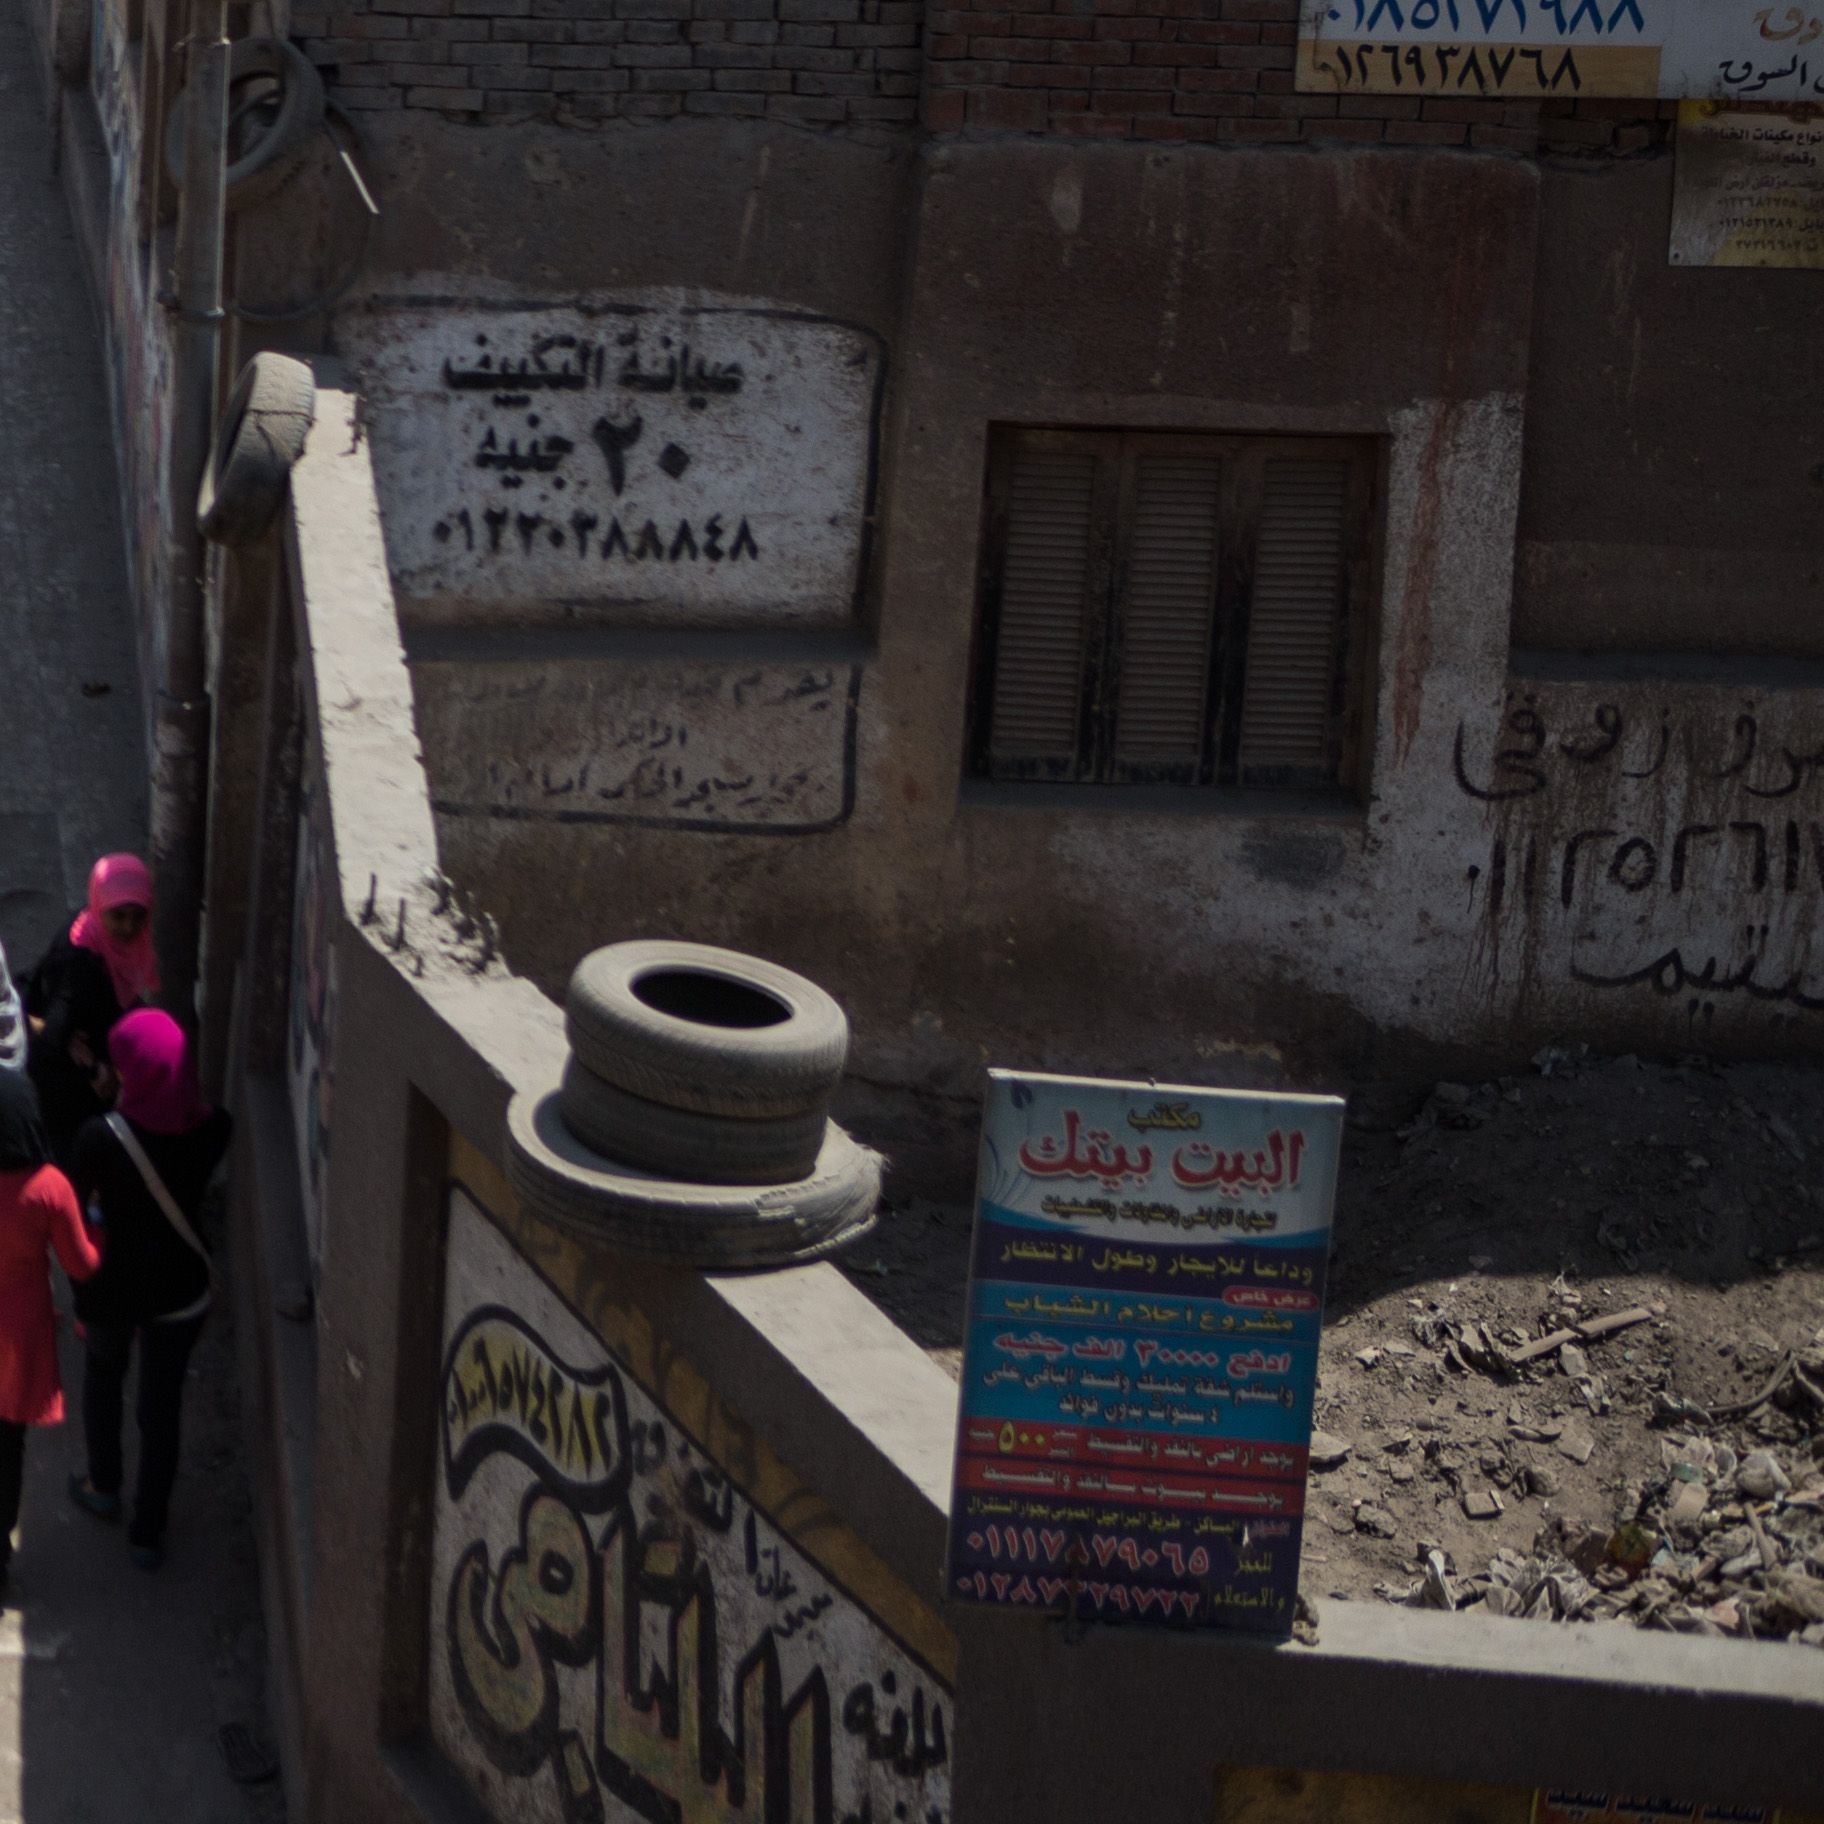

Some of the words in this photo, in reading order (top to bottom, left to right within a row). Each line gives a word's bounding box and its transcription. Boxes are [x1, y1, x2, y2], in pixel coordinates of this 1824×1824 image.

[443, 335, 605, 407] التكييف
[619, 326, 743, 410] صيانة
[474, 414, 575, 489] جنيه
[1128, 1102, 1201, 1132] مكتب
[1019, 1109, 1152, 1192] بيتك
[1172, 1128, 1306, 1198] البيت
[1000, 1239, 1083, 1264] الانتظار
[1092, 1245, 1158, 1274] وطول
[1005, 1294, 1109, 1318] الشباب
[1232, 1288, 1272, 1305] خاص
[1118, 1303, 1192, 1325] احلام
[1199, 1309, 1295, 1333] مشروع
[993, 1330, 1068, 1360] جنيه
[1072, 1335, 1126, 1361] الف
[1228, 1350, 1293, 1379] ادفع
[1103, 1395, 1145, 1422] بدون
[1148, 1396, 1206, 1426] سنوات
[996, 1420, 1046, 1454] ٥٠٠
